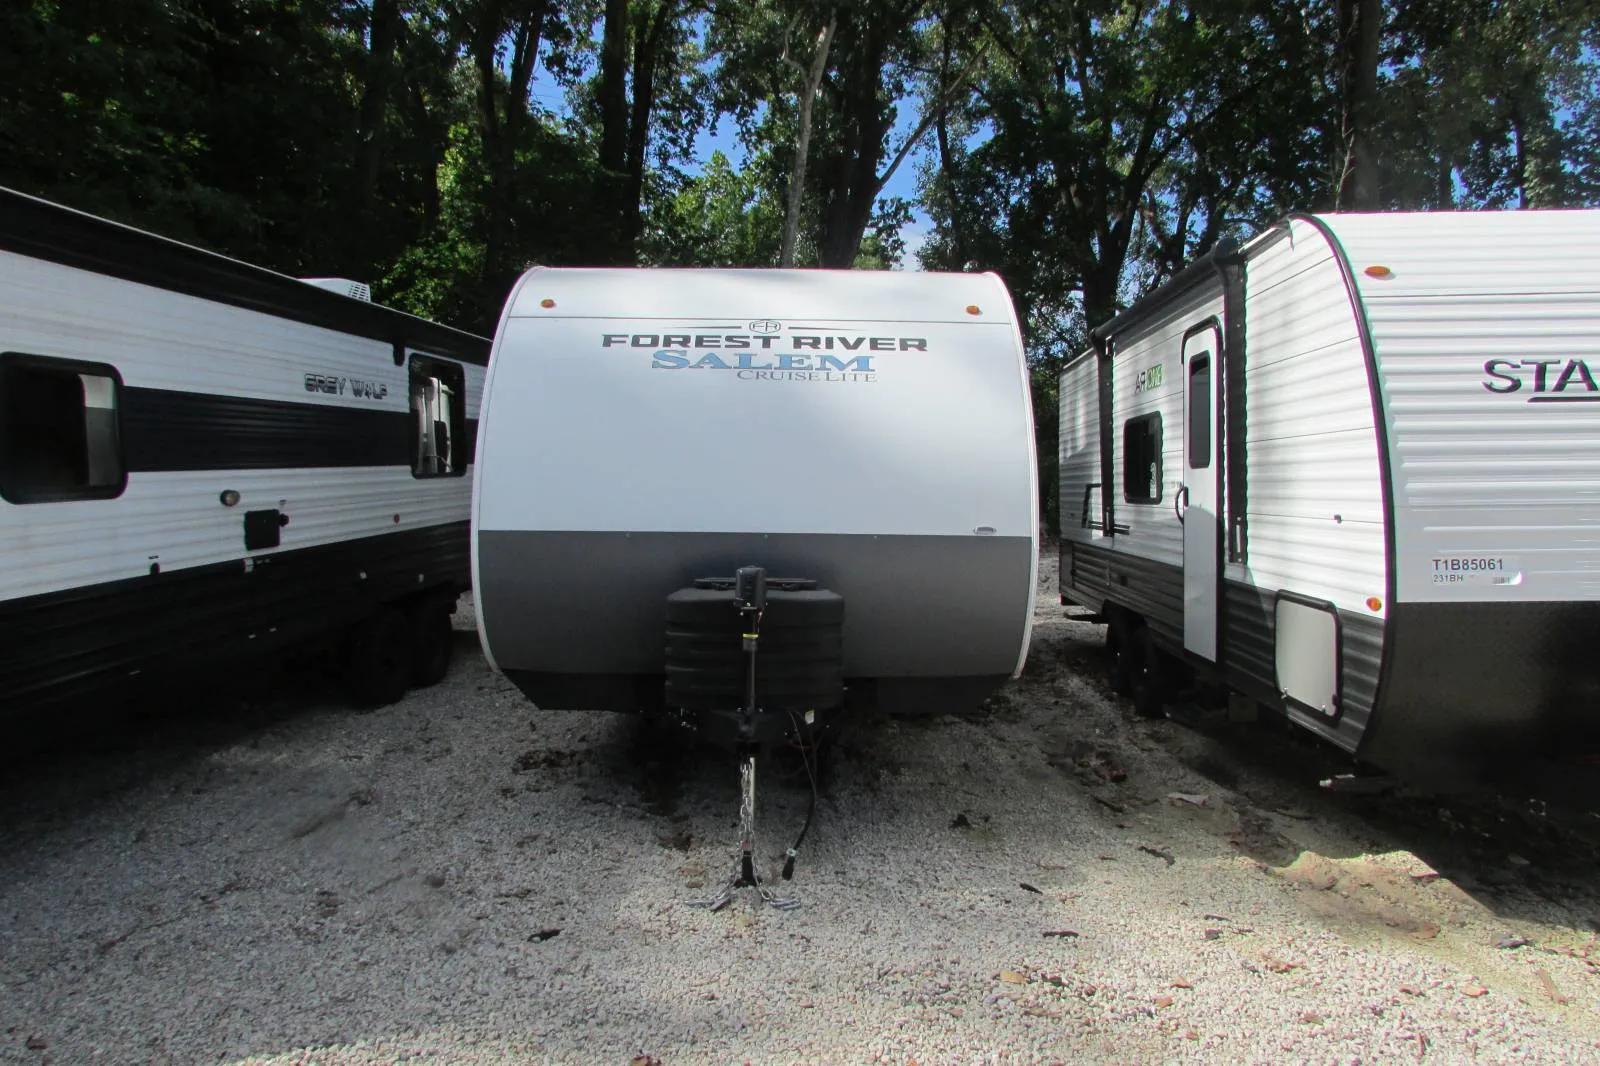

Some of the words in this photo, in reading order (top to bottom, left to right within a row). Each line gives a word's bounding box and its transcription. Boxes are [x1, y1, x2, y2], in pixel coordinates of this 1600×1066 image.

[602, 334, 780, 348] FOREST
[792, 336, 928, 352] RIVER
[651, 350, 876, 372] SALEM
[304, 373, 346, 395] GREY
[1432, 558, 1504, 571] T1B85061
[1433, 574, 1464, 583] 231BH
